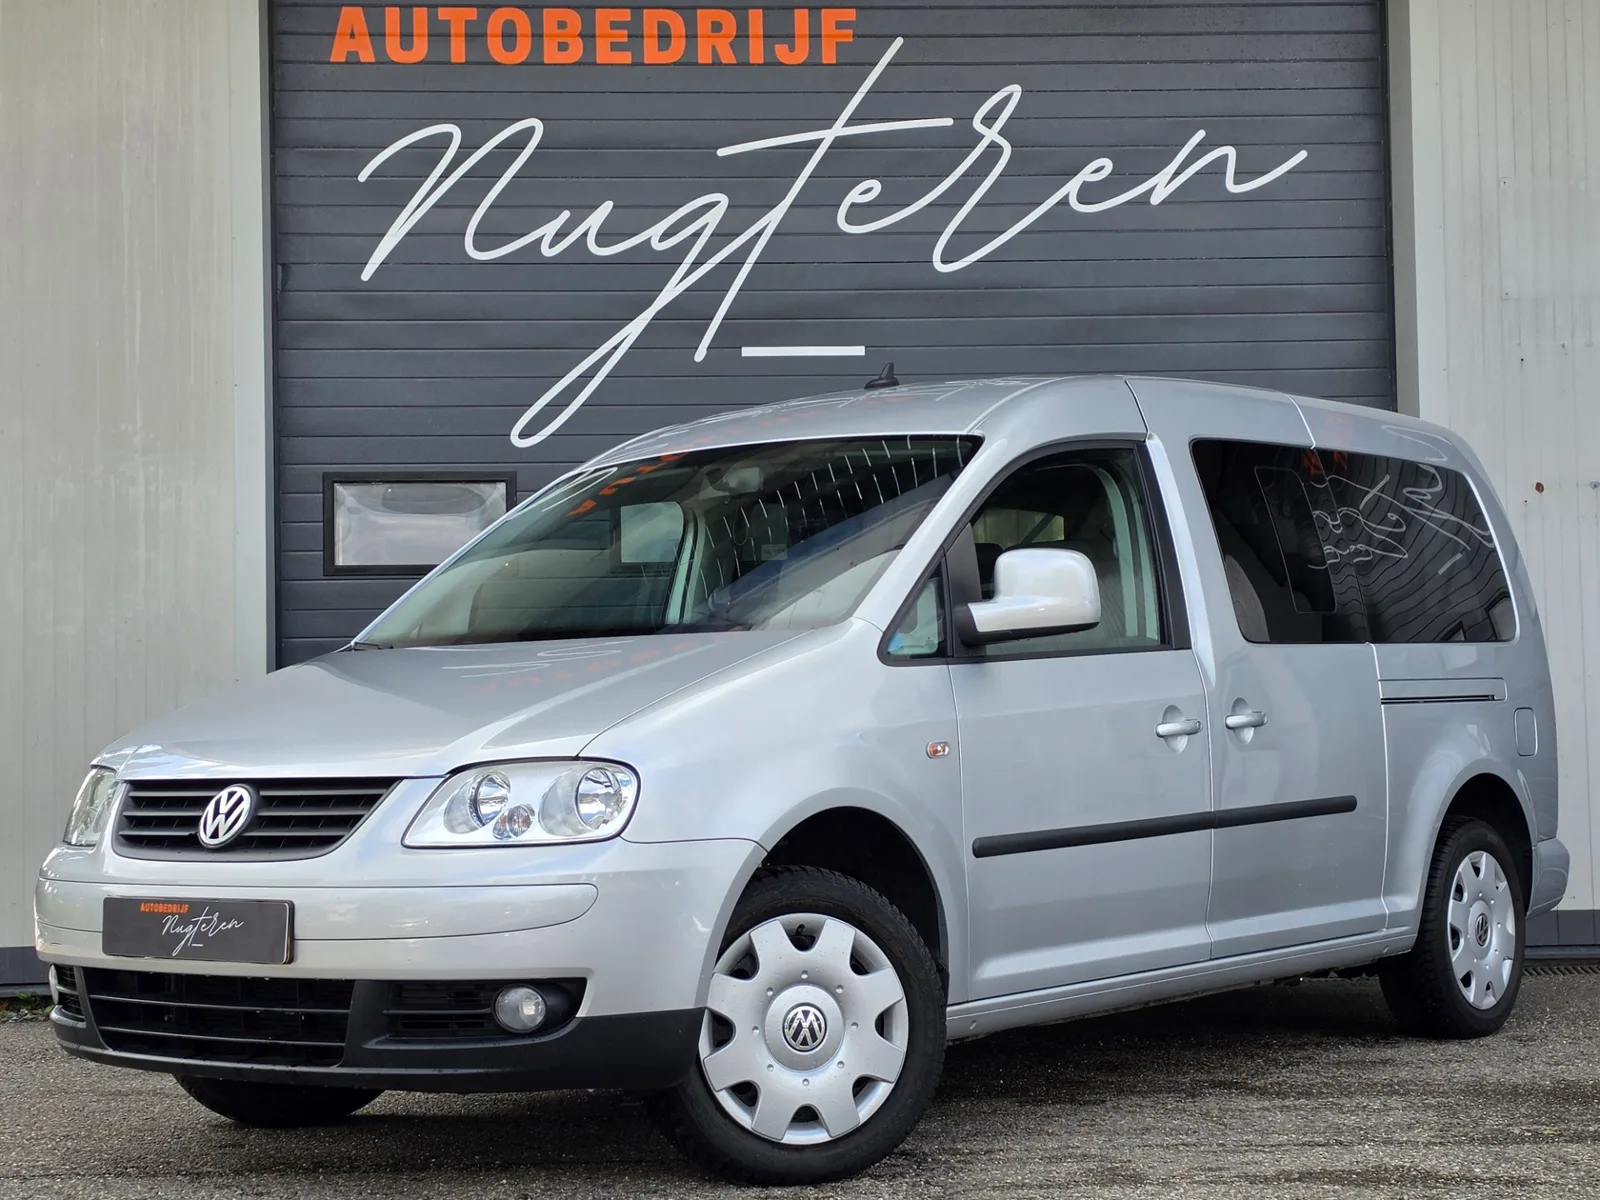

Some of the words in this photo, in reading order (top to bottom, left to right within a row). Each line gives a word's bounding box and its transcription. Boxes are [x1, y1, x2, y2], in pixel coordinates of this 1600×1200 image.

[331, 7, 857, 65] AUTOBEDRIJF
[357, 36, 1308, 449] Nugteren
[139, 902, 190, 913] AUTOBEDRIJF
[162, 905, 244, 956] Nugteren
